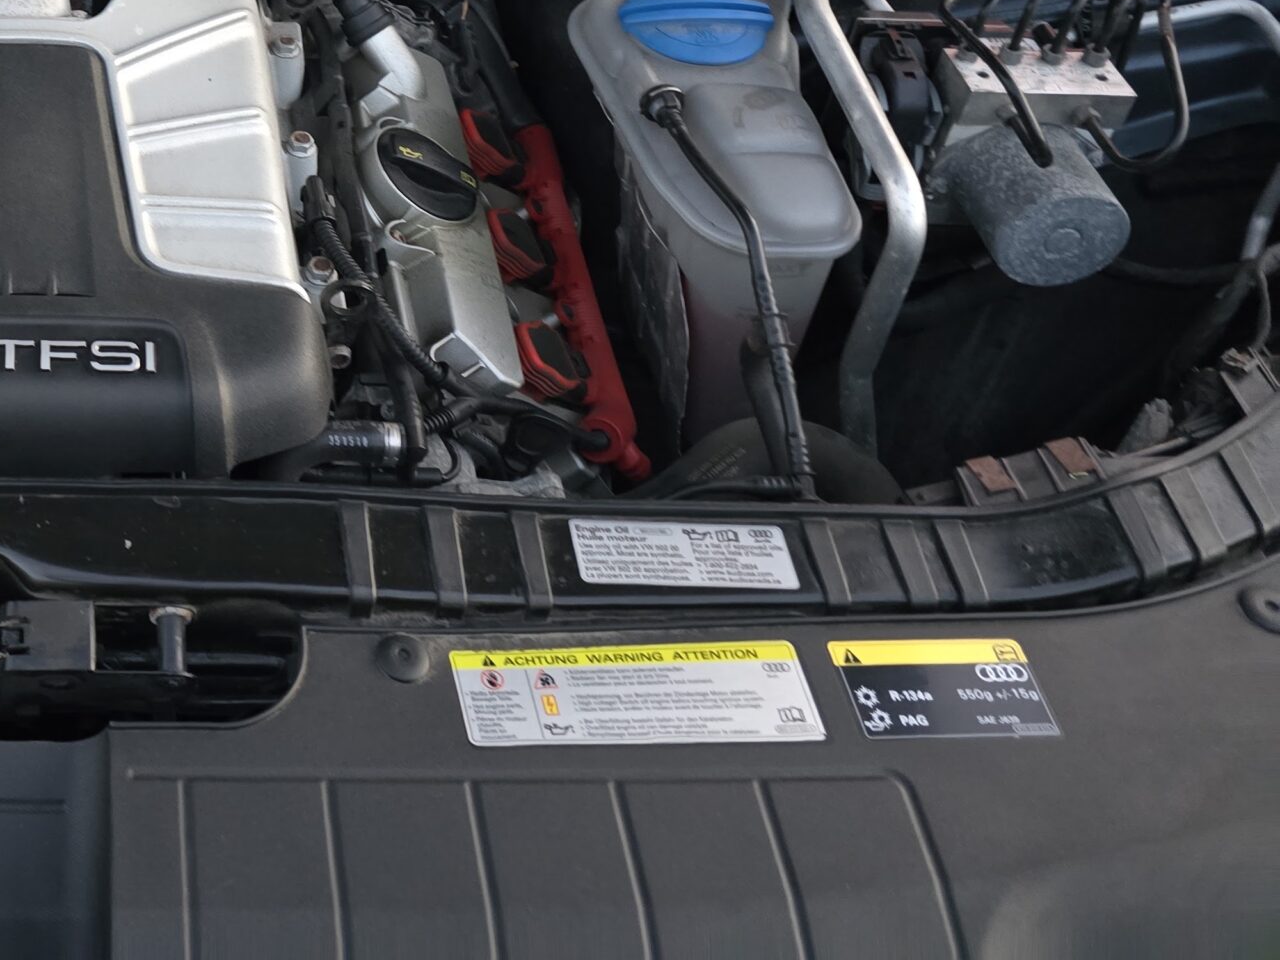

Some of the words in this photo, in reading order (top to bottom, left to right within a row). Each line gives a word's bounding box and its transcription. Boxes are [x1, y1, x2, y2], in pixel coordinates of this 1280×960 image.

[574, 524, 613, 536] Engine
[614, 525, 629, 534] Oil
[576, 532, 604, 541] Huile
[606, 534, 648, 542] moteur
[503, 654, 578, 667] ACHTUNG
[585, 651, 665, 664] WARNING
[672, 648, 759, 661] ATTENTION
[888, 689, 934, 702] R-134a
[899, 715, 930, 728] PAG
